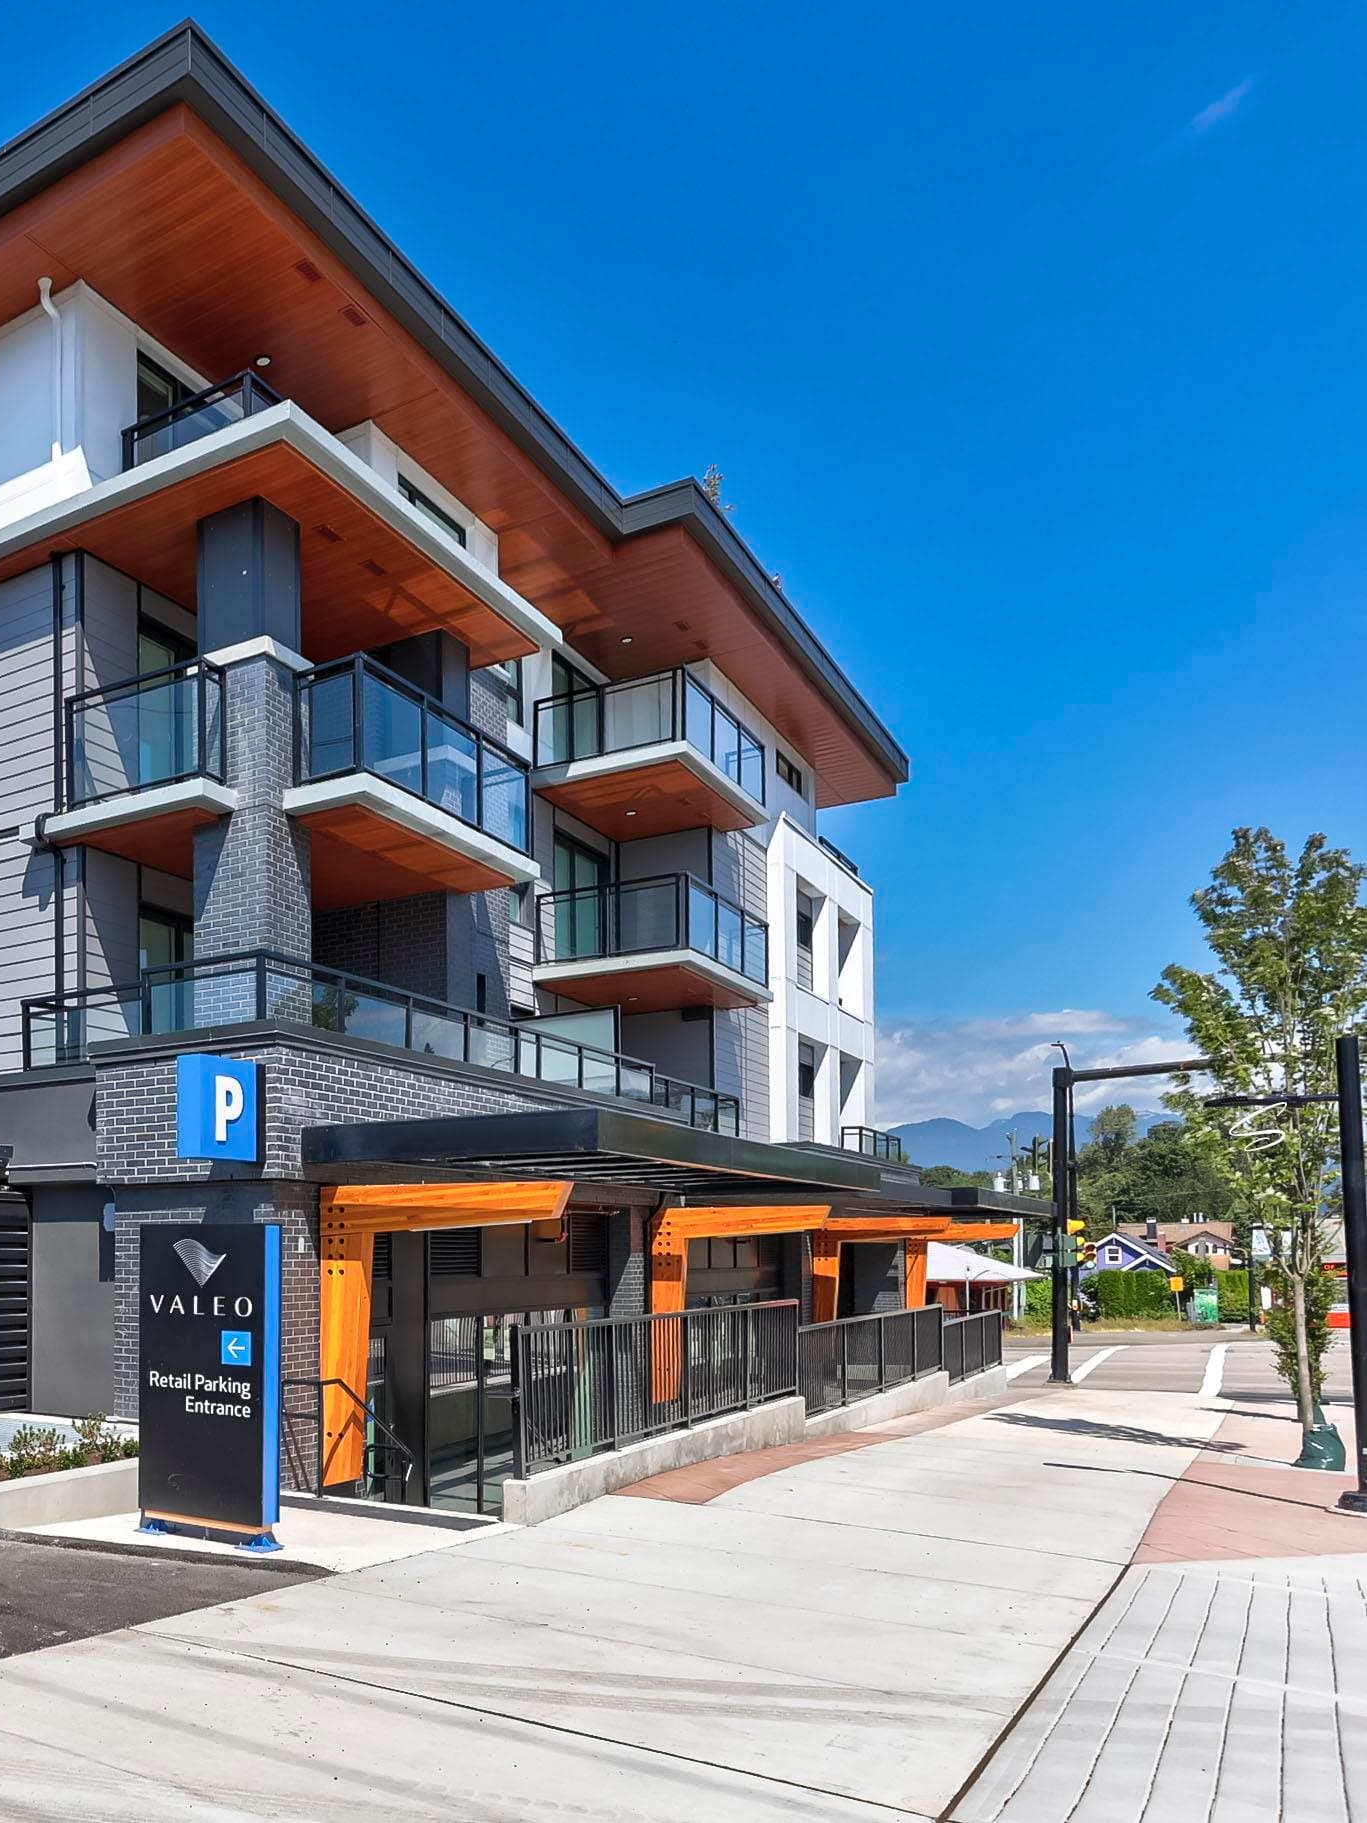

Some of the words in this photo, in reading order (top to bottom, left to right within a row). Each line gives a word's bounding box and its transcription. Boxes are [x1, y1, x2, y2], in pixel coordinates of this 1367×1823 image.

[215, 1075, 244, 1141] P
[149, 1294, 253, 1317] VALEO
[149, 1370, 191, 1390] Retail
[195, 1373, 251, 1400] Parking
[185, 1395, 251, 1418] Entrance
